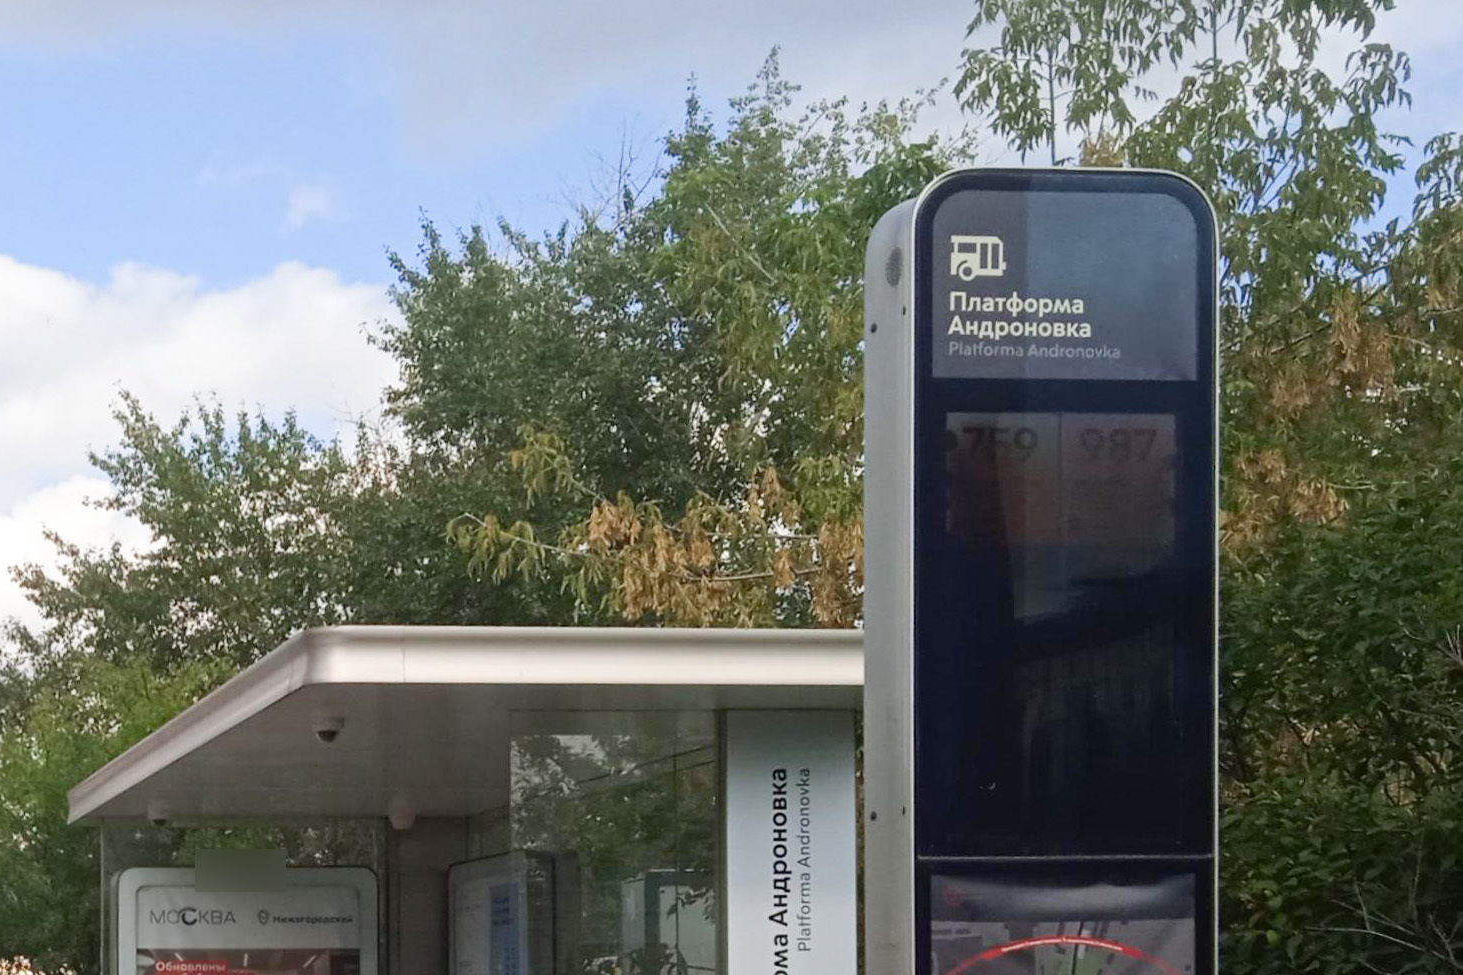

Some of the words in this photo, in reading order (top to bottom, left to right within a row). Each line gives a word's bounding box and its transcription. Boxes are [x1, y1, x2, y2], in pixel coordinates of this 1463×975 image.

[949, 291, 1084, 318] Платформа
[947, 315, 1092, 341] Андроновка
[948, 341, 1024, 358] Platforma
[1027, 343, 1121, 360] Andronovka
[795, 767, 811, 868] Andronovka
[768, 768, 792, 926] Андроновка
[149, 906, 236, 926] МОСКВА
[796, 872, 811, 952] Platforma
[155, 961, 226, 972] Обновлены
